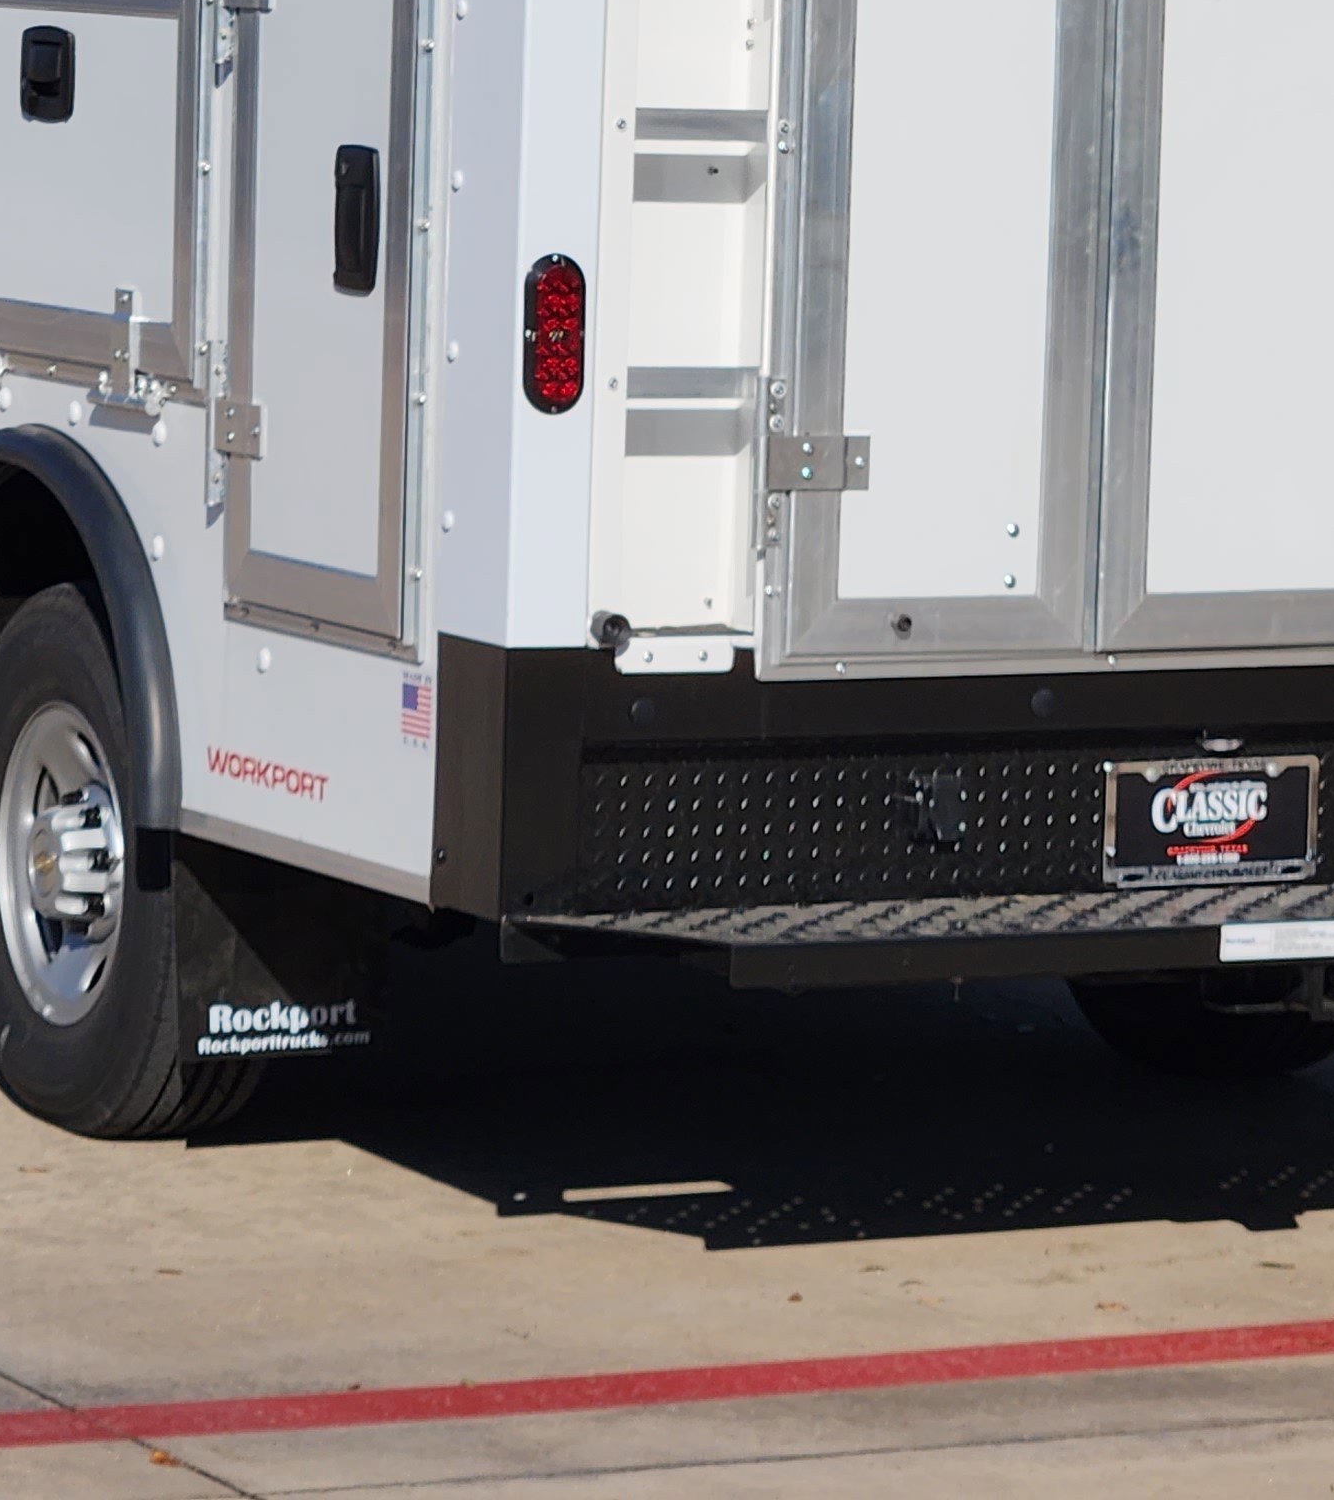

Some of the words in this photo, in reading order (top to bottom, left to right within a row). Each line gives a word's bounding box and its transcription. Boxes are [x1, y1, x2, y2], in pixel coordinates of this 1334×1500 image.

[207, 745, 329, 802] WORKPORT
[1151, 787, 1268, 834] CLASSIC
[208, 999, 357, 1035] Rockport
